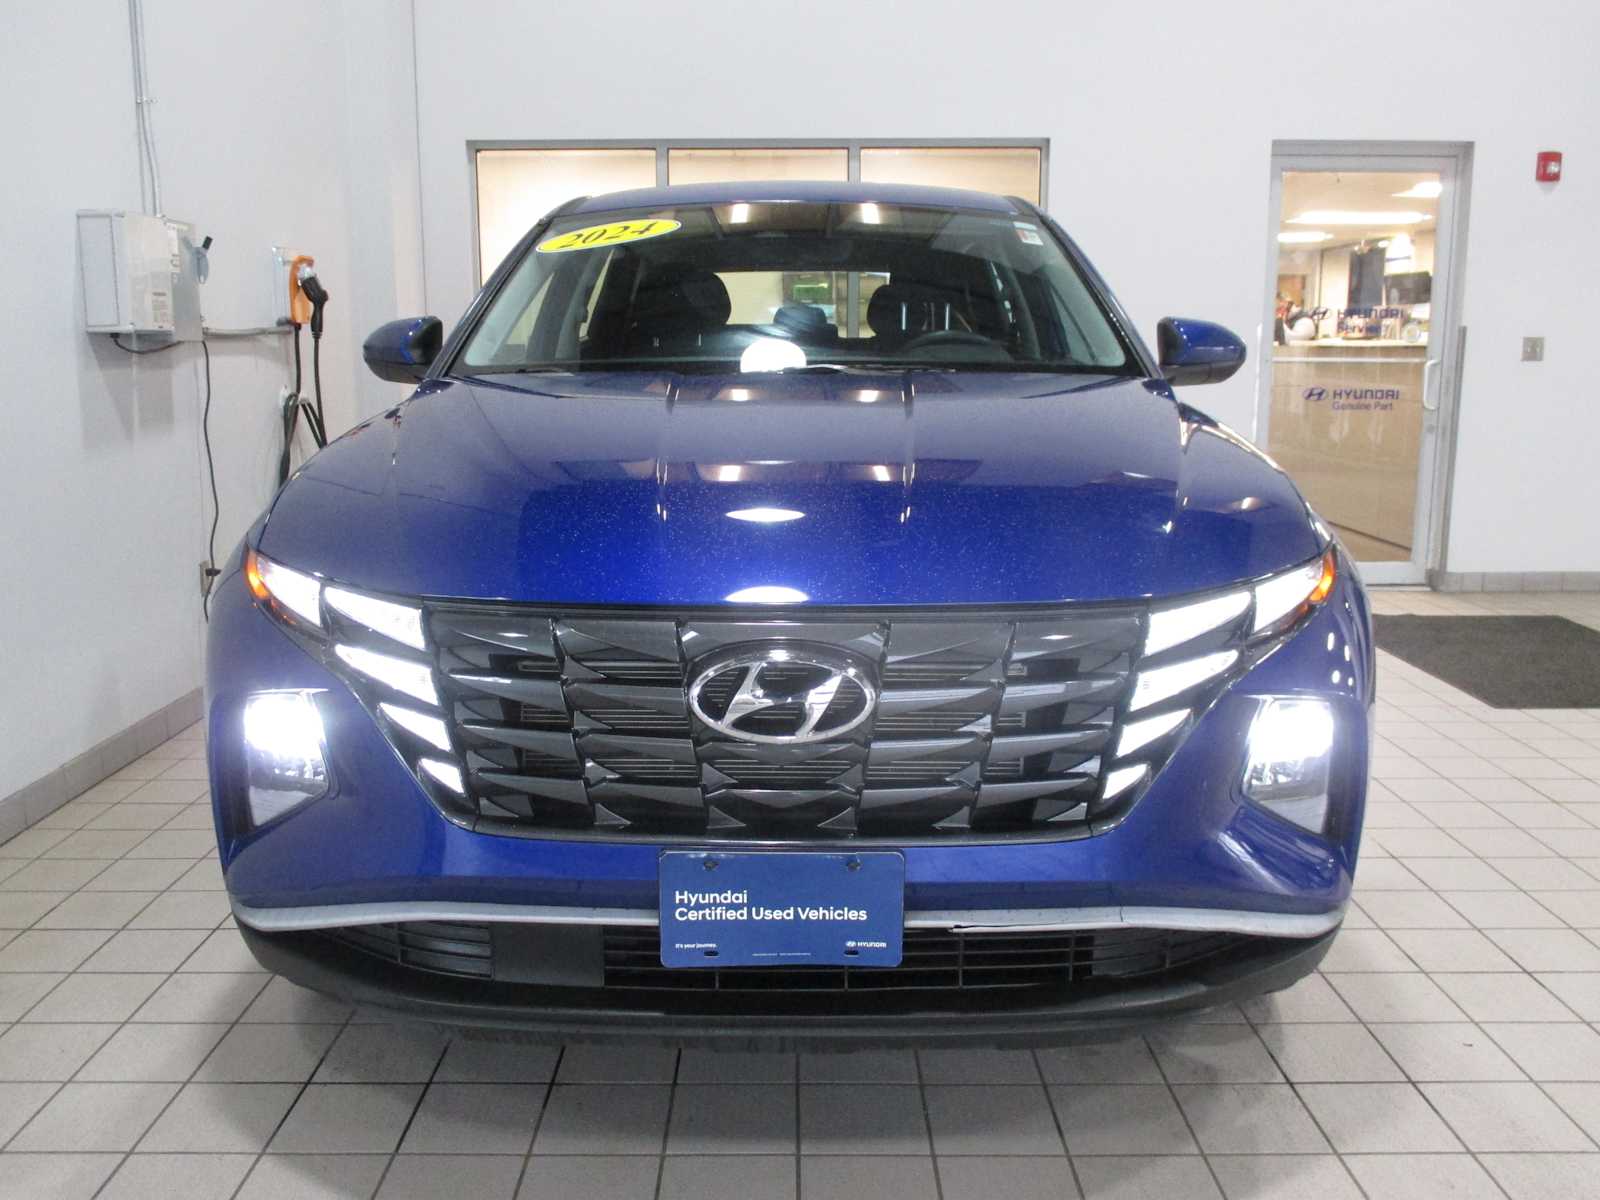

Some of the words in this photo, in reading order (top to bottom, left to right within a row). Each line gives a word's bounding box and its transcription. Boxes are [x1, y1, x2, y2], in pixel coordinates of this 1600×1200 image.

[559, 221, 658, 248] 2024
[1337, 308, 1404, 320] HYUNDAI
[1333, 389, 1400, 400] HYUNDAI
[1332, 401, 1372, 411] Genuine
[675, 890, 748, 906] Hyundai
[675, 907, 748, 921] Certified
[751, 907, 794, 921] Used
[797, 907, 868, 921] Vehicles
